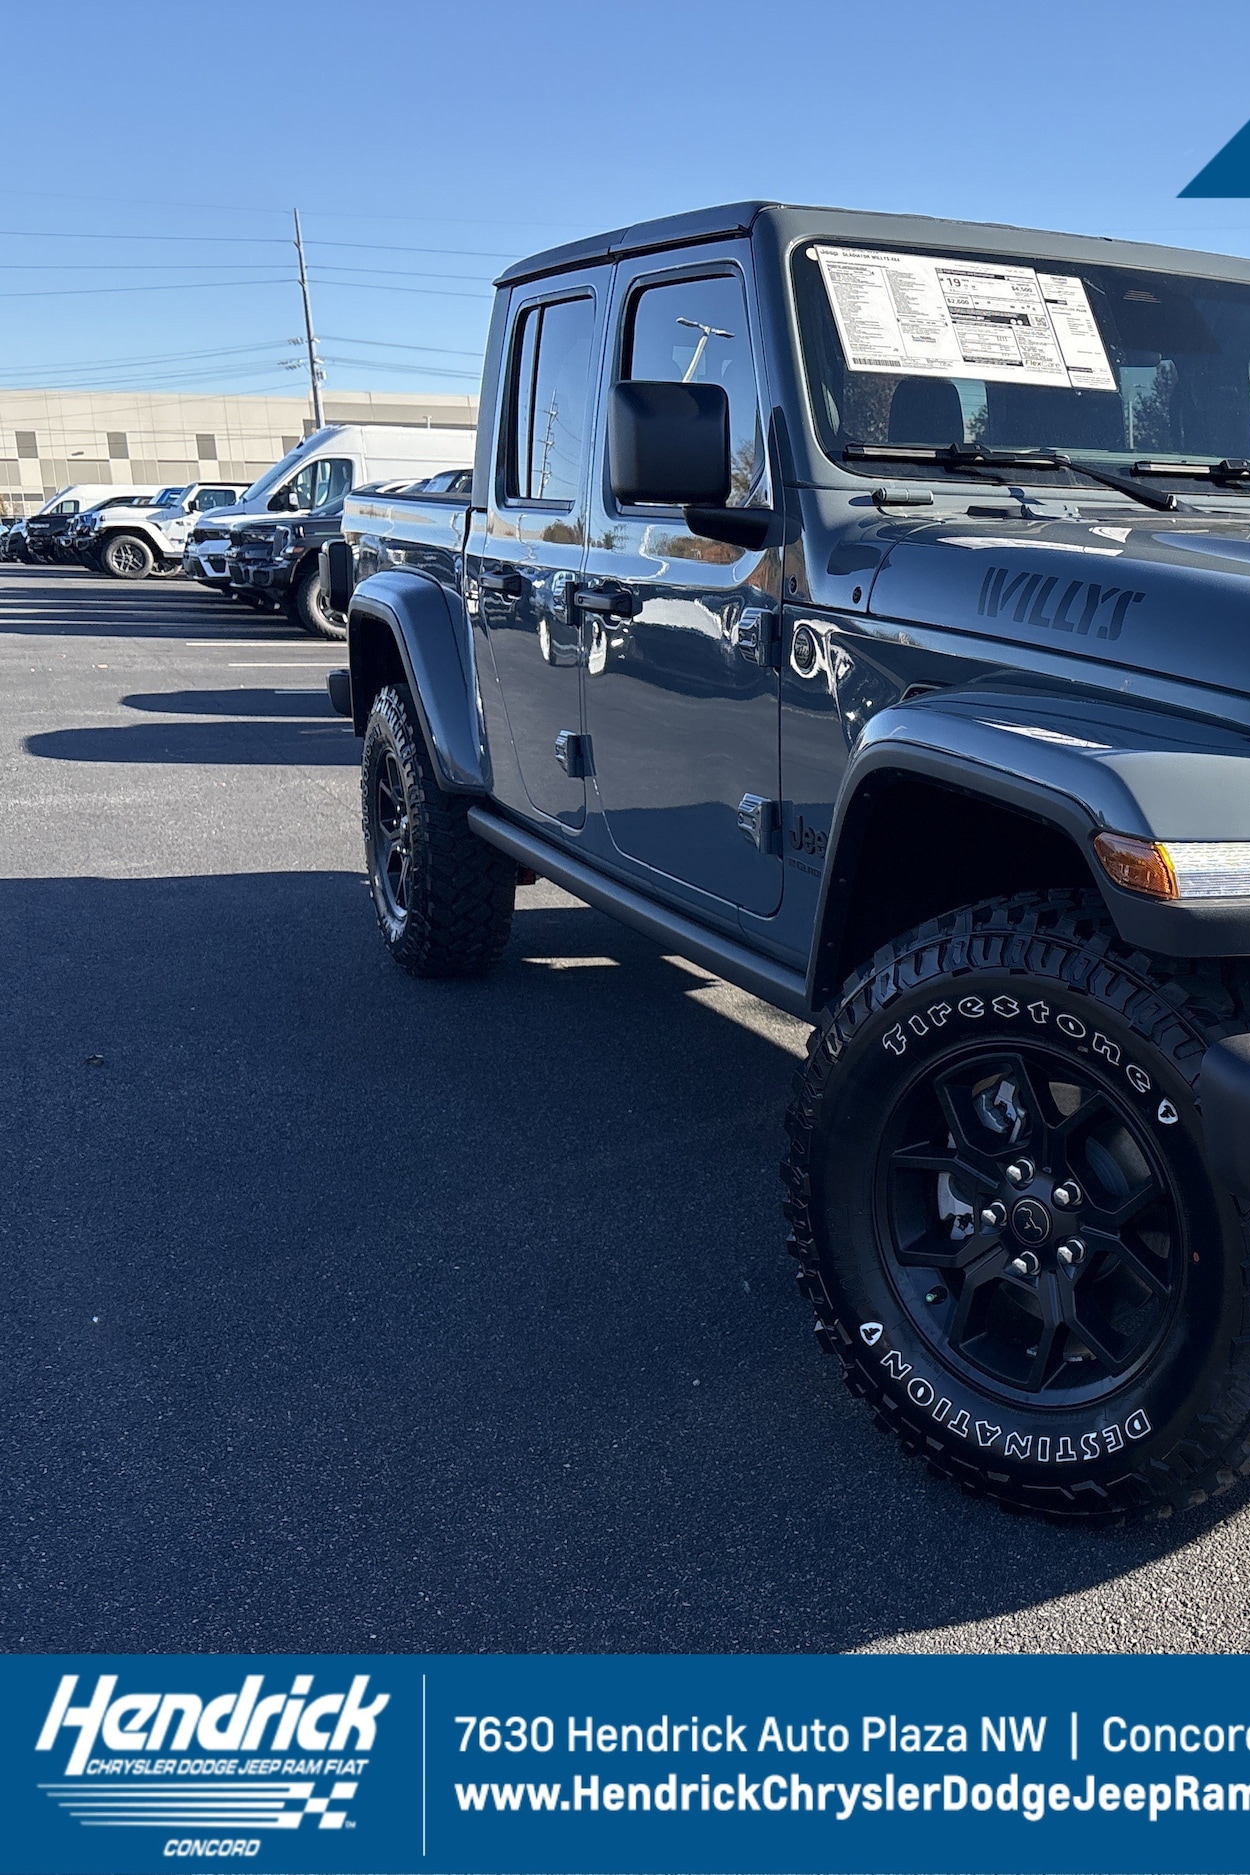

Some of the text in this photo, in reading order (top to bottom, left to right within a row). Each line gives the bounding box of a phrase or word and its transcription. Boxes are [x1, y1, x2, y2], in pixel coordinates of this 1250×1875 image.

[946, 277, 961, 288] 19
[977, 566, 1146, 641] WILLYS
[789, 815, 829, 859] Jee
[883, 995, 1151, 1093] Firestone
[880, 1350, 1152, 1463] DESTINATION
